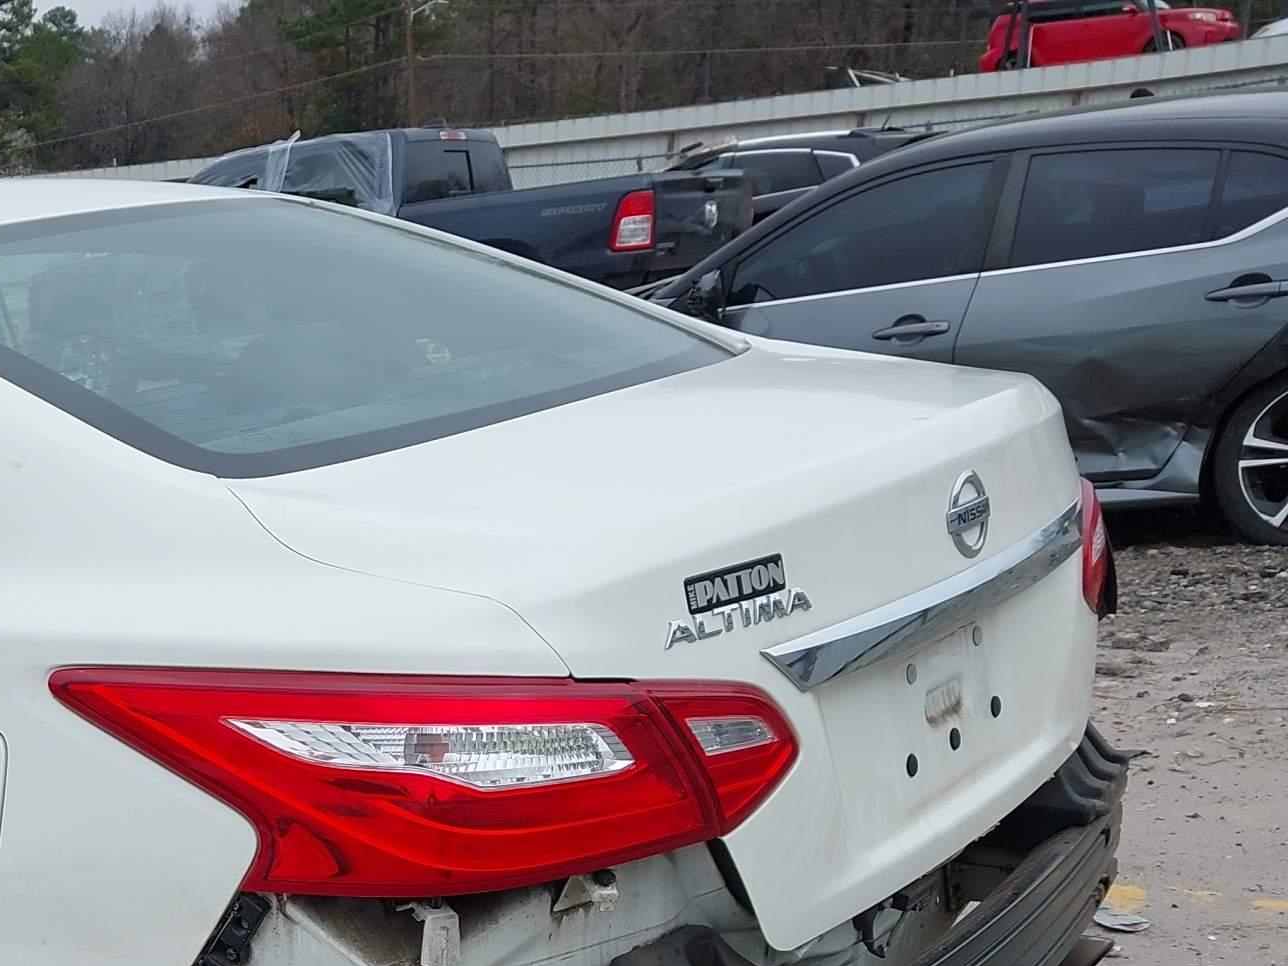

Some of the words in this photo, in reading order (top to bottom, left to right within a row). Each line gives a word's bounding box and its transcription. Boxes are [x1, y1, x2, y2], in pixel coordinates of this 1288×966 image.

[686, 584, 698, 609] MIKE
[694, 560, 784, 607] PATTON
[664, 587, 812, 650] ALTIMA
